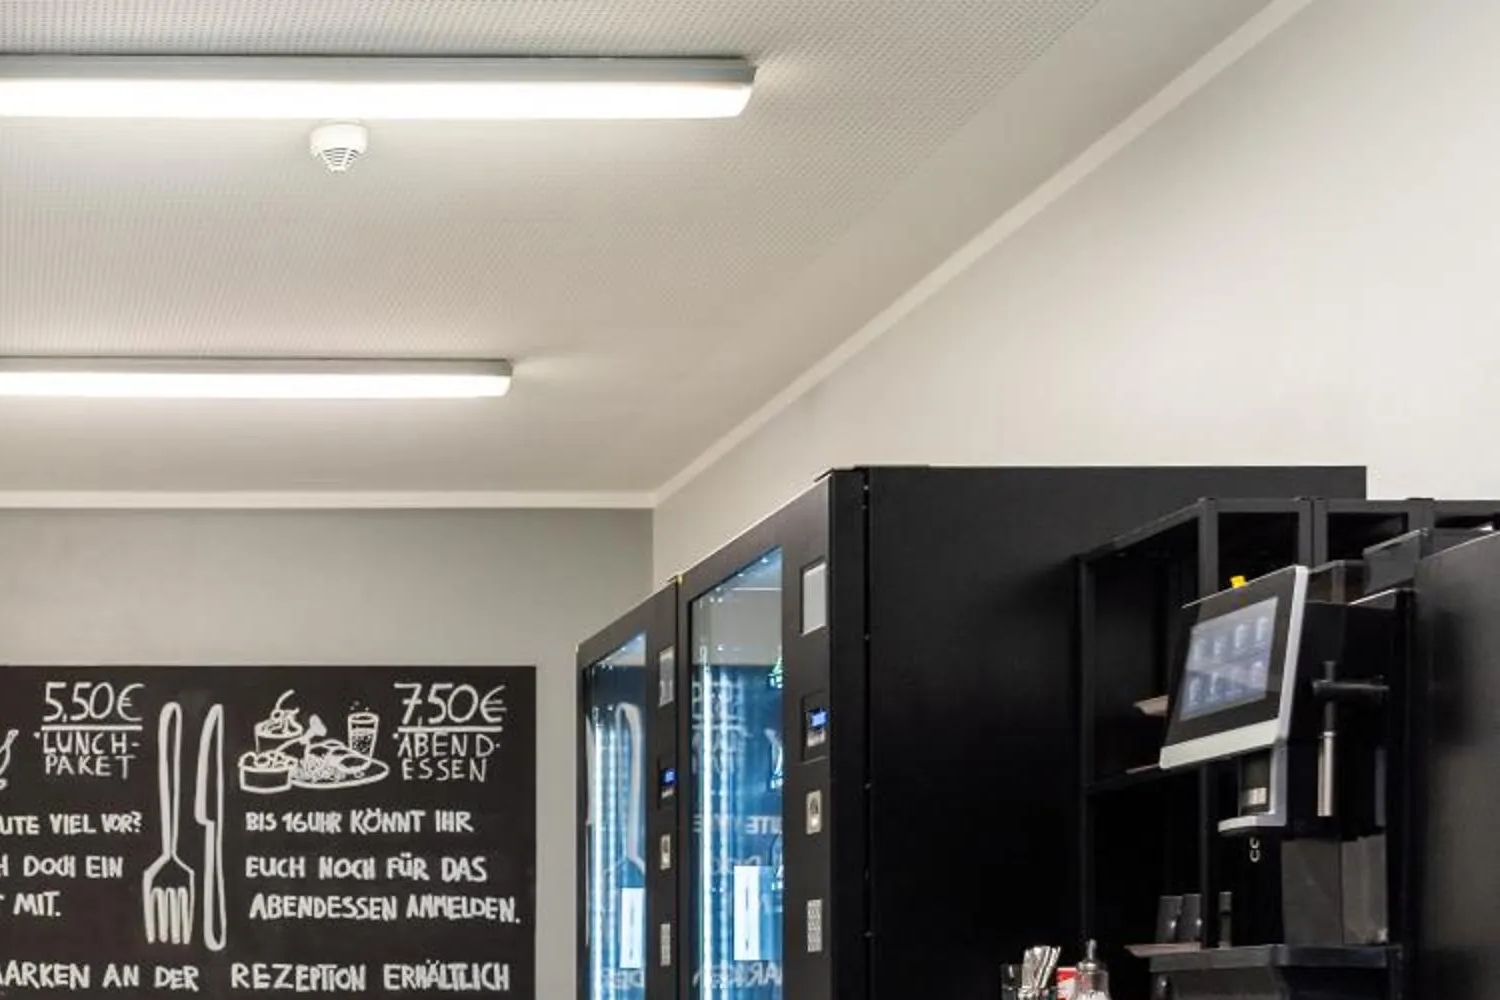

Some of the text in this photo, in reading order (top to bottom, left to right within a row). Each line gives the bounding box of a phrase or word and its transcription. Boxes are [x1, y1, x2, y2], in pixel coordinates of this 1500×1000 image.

[45, 755, 136, 780] PAKET
[402, 759, 487, 782] ESSEN
[50, 813, 96, 835] VIEL
[102, 811, 143, 834] VOR?
[245, 811, 277, 832] BIS
[351, 808, 426, 834] KÖNNT
[436, 810, 474, 832] IHR
[23, 855, 76, 879] DOCH
[86, 856, 124, 878] EIN
[246, 852, 487, 882] EUCH NOCH FÜR DAS
[13, 891, 61, 917] MIT.
[249, 893, 521, 923] ABENDESSEN ANMELDEN.
[102, 964, 139, 989] AN
[155, 965, 199, 991] DER
[231, 963, 366, 992] REZEPTION
[384, 958, 510, 991] ERHÄLTLICH
